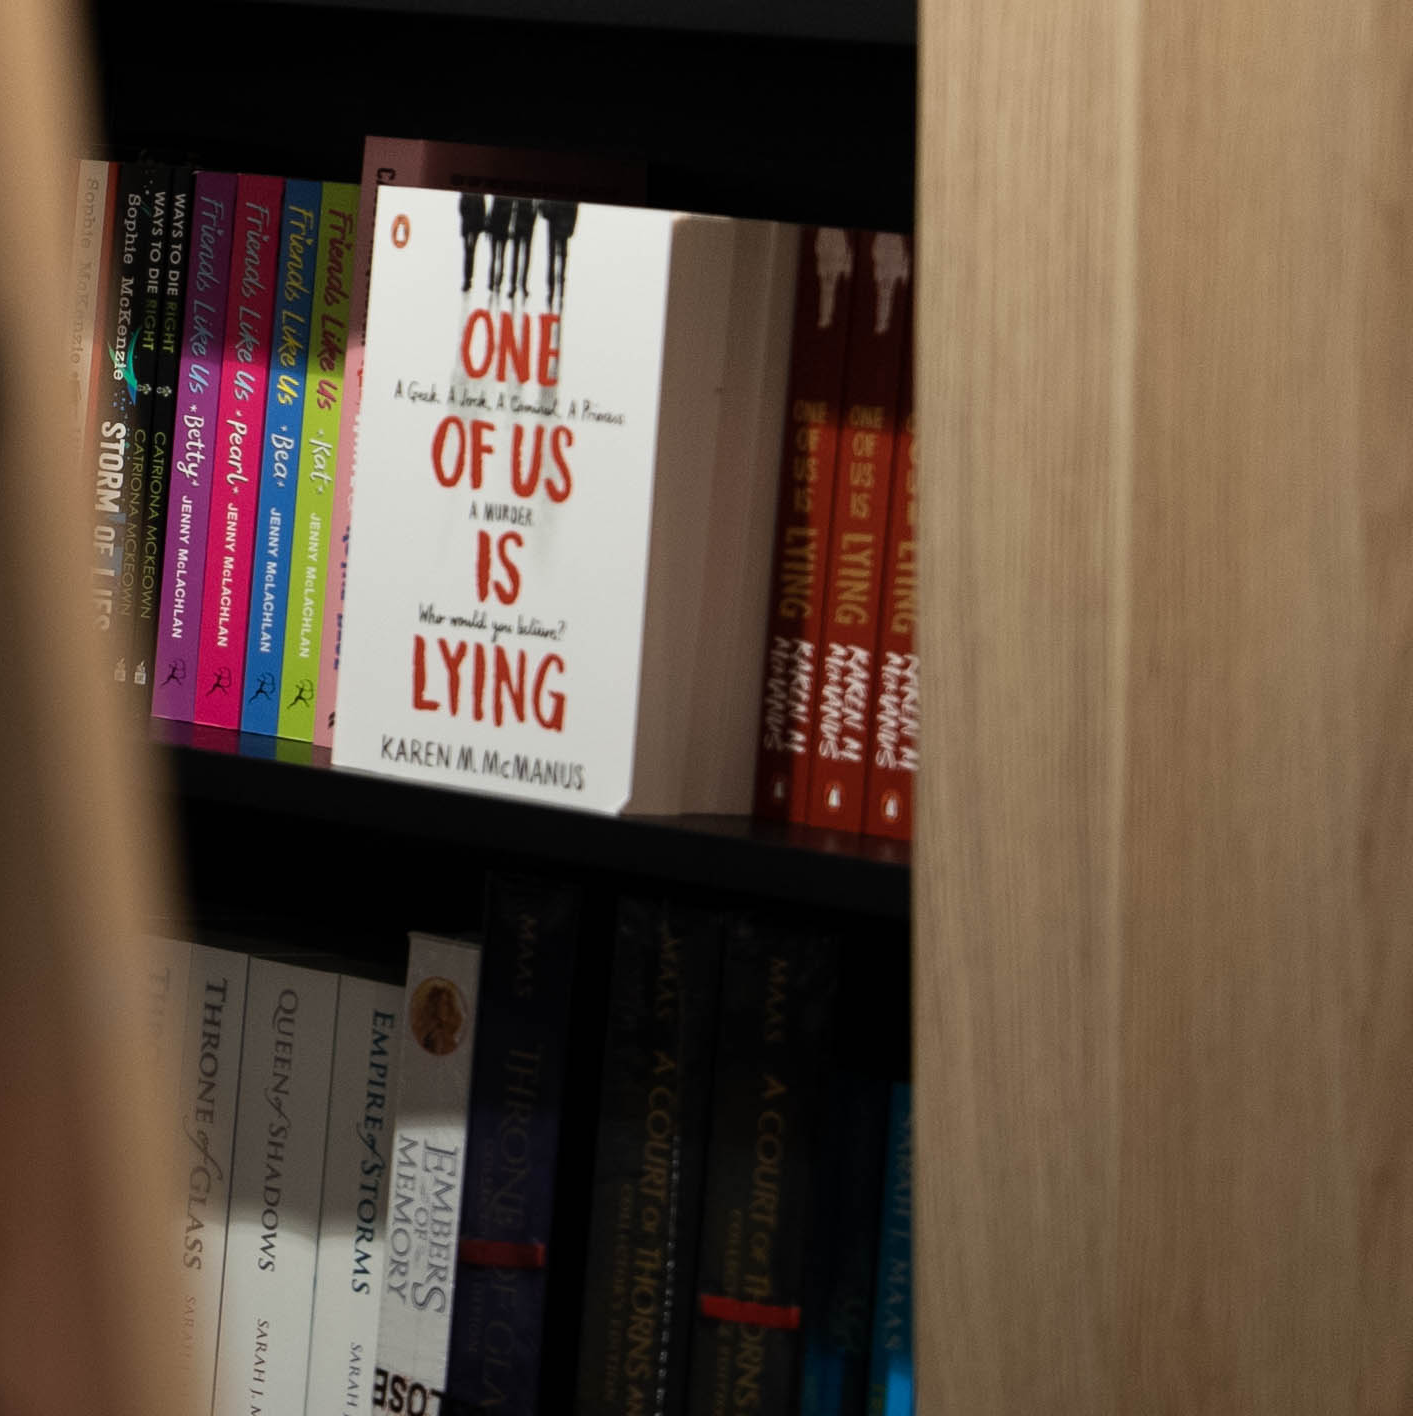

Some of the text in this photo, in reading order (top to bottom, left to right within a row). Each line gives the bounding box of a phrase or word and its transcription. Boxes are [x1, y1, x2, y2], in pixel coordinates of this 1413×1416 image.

[113, 193, 142, 381] Sophie McKenzie
[141, 191, 166, 352] WAYS TO DIE RIGHT
[162, 193, 187, 353] WAYS TO DIE RIGHT
[193, 195, 224, 294] Friends
[240, 201, 271, 300] Friends
[284, 204, 315, 304] Friends
[324, 207, 354, 308] Friends
[189, 298, 216, 357] Like
[236, 304, 262, 363] Like
[277, 308, 304, 368] Like
[318, 314, 345, 373] Like
[461, 308, 562, 388] ONE
[188, 363, 210, 395] Us
[233, 369, 256, 402] Us
[276, 375, 299, 407] Us
[316, 380, 338, 411] Us
[93, 421, 127, 557] STORM OF
[431, 415, 576, 505] OF US
[140, 431, 166, 619] CATRIONA MCKEOWN
[469, 500, 534, 527] A MURDER
[171, 496, 193, 639] JENNY McLACHLAN
[216, 503, 239, 647] JENNY McLACHLAN
[259, 507, 282, 653] JENNY McLACHLAN
[299, 513, 322, 660] JENNY McLACHLAN
[475, 530, 526, 607] IS
[778, 527, 818, 621] LYING
[834, 532, 876, 626] LYING
[418, 602, 446, 625] Who
[450, 610, 487, 630] would
[491, 621, 513, 644] you
[412, 634, 566, 733] LYING
[380, 734, 586, 792] KAREN M. McMANUS
[183, 978, 230, 1270] THRONE GLASS
[258, 987, 299, 1272] QUEEN SHADOWS
[352, 1009, 396, 1295] EMPIRE STORMS
[386, 1133, 421, 1303] MEMORY
[411, 1137, 458, 1315] EMBERS
[414, 1204, 430, 1244] OF
[253, 1318, 270, 1383] SARAH
[346, 1341, 363, 1407] SARAH
